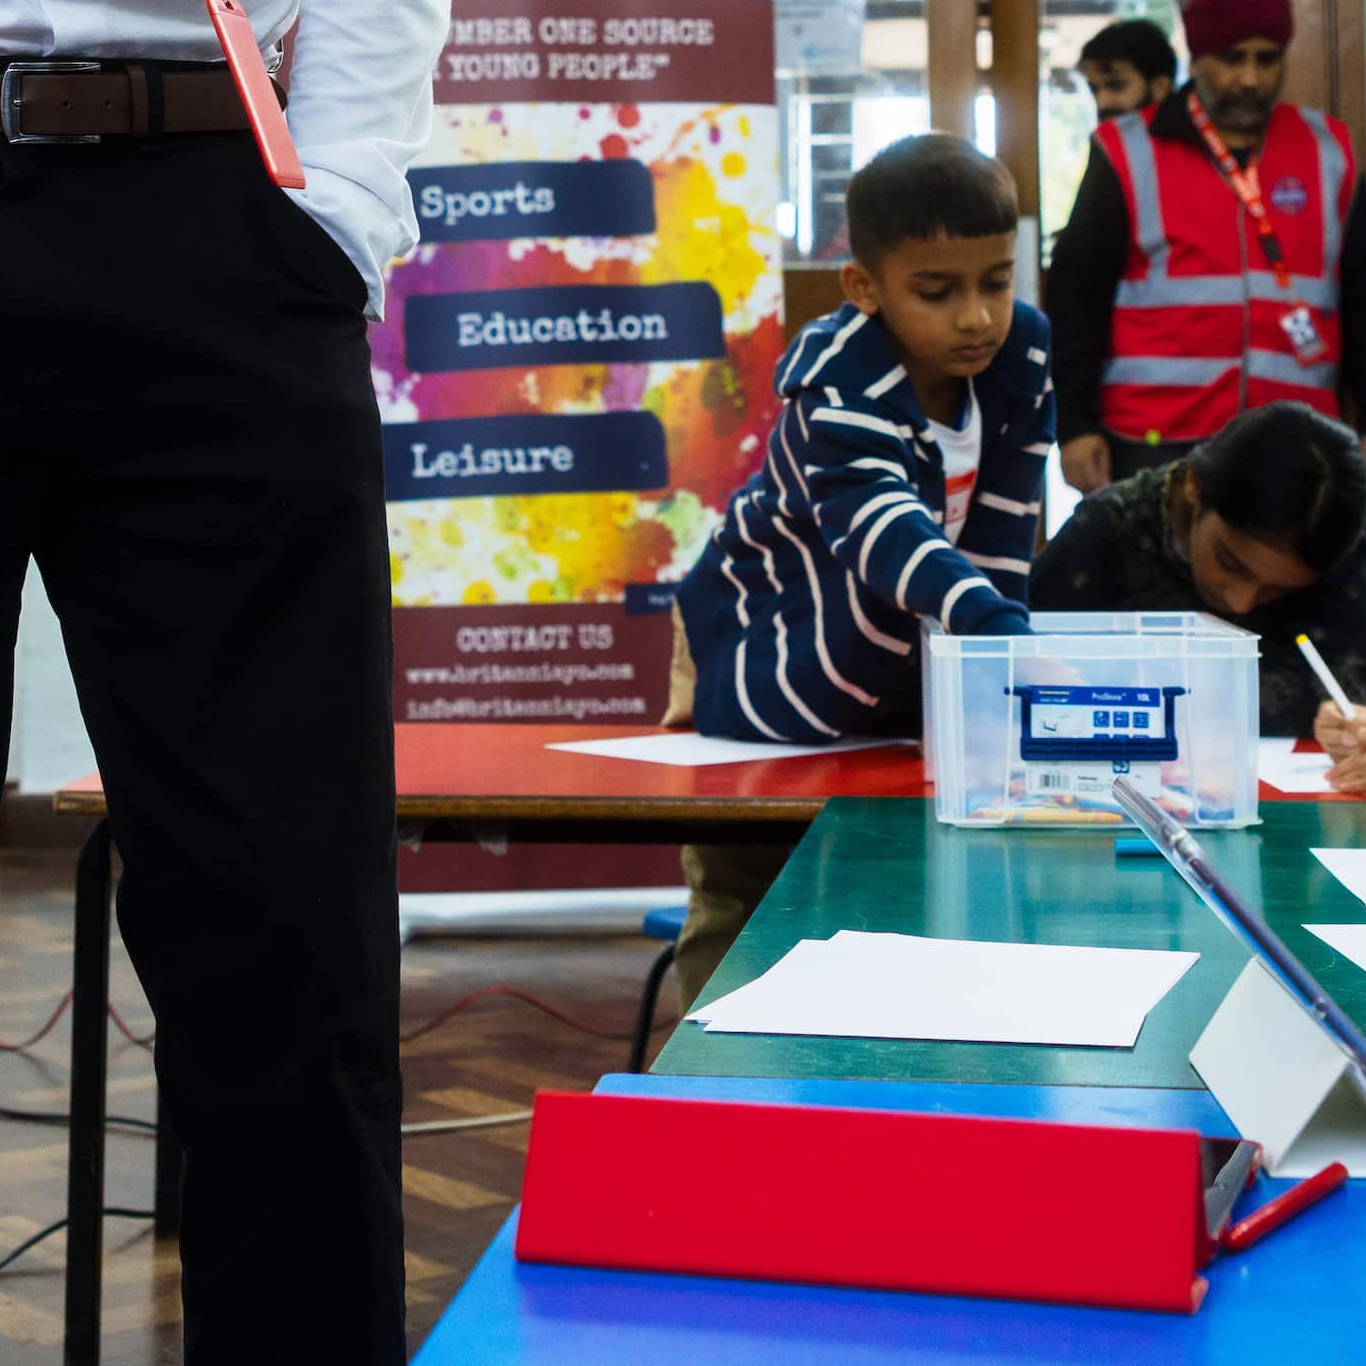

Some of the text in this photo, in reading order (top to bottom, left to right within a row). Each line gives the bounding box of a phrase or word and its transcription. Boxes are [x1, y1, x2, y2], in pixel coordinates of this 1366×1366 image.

[538, 17, 597, 45] ONE
[603, 18, 715, 46] SOURCE
[447, 52, 540, 81] YOUNG
[420, 182, 556, 226] Sports
[456, 308, 669, 347] Education
[410, 442, 574, 478] Leisure
[455, 624, 614, 653] CONTACT US
